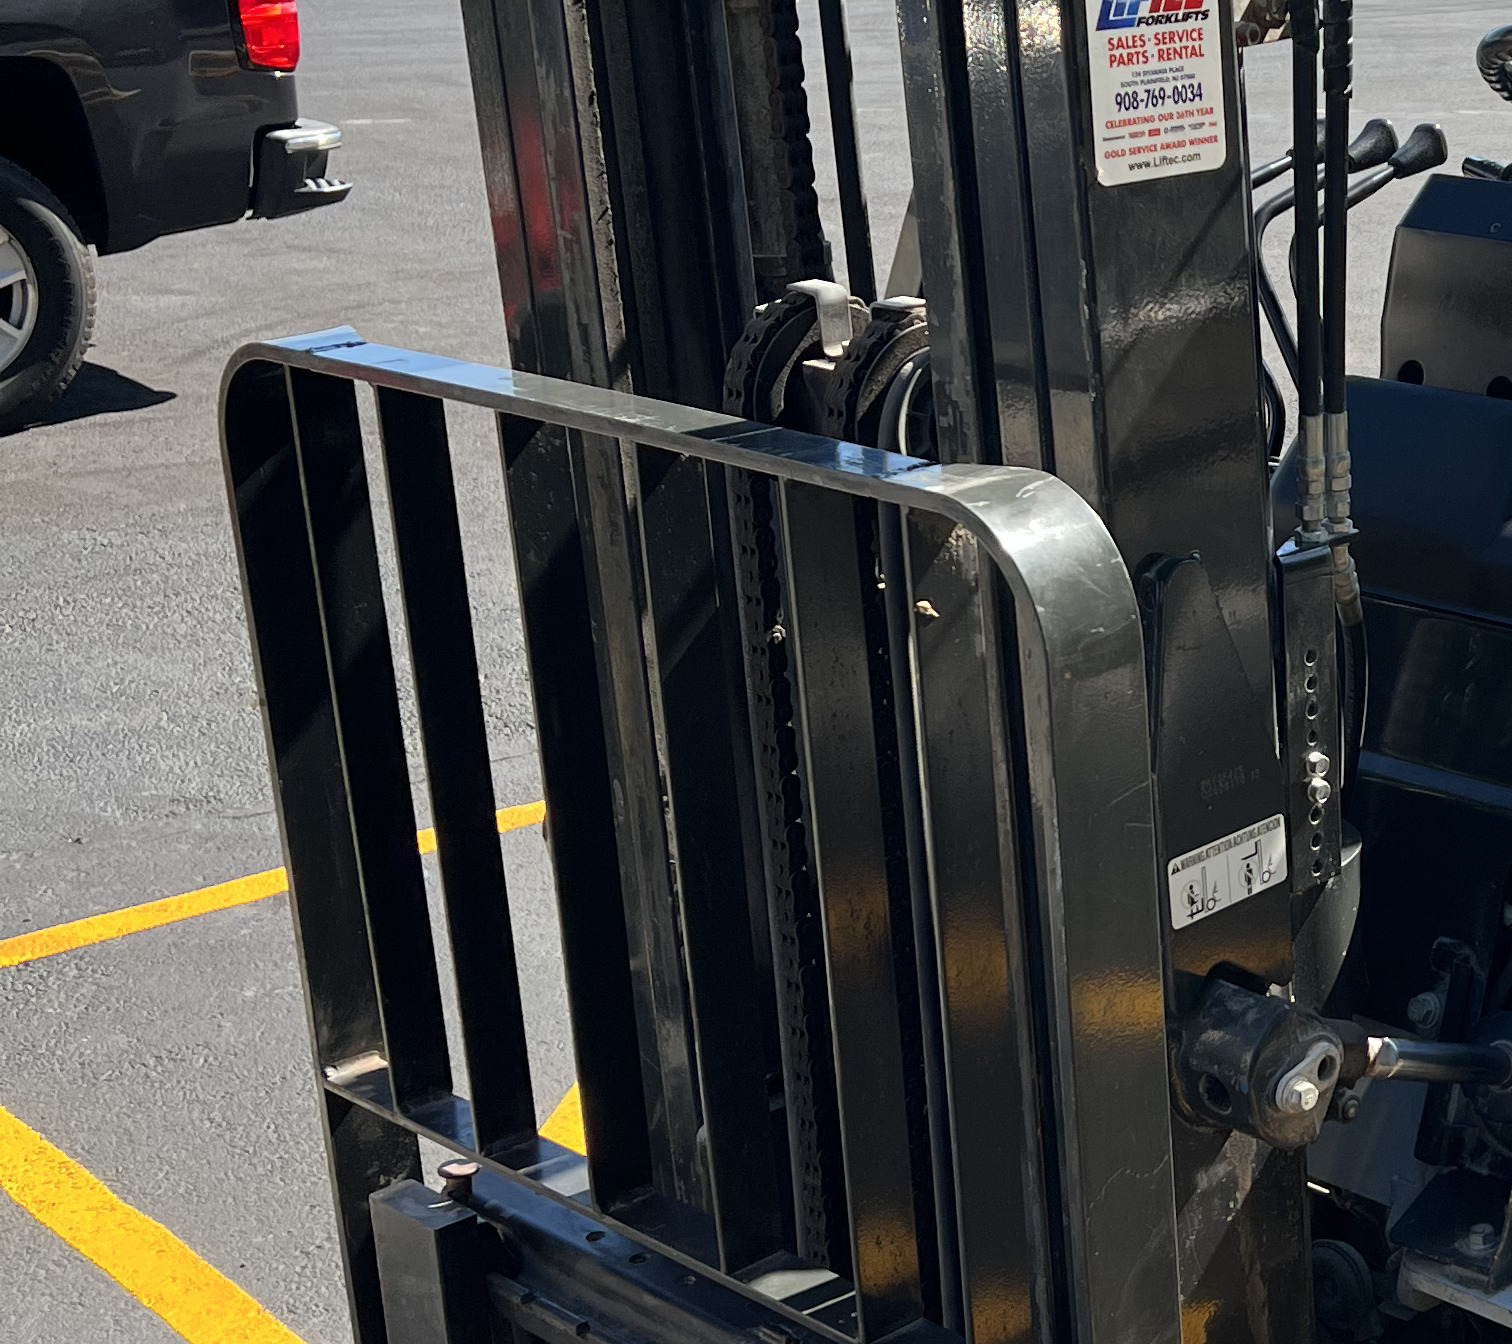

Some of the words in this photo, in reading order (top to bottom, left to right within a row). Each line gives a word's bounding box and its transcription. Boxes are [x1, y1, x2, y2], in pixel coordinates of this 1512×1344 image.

[1137, 9, 1210, 27] FORKLIFTS
[1108, 34, 1146, 51] SALES
[1153, 28, 1204, 46] SERVICE
[1109, 50, 1149, 68] PARTS
[1158, 43, 1204, 62] RENTAL
[1115, 82, 1203, 112] 908-769-0034
[1105, 115, 1155, 130] CELEBRATING
[1158, 112, 1174, 122] OUR
[1196, 107, 1214, 117] YEAR
[1104, 148, 1126, 159] GOLD
[1129, 144, 1158, 156] SERVICE
[1160, 139, 1187, 151] AWARD
[1189, 135, 1218, 146] WINNER
[1128, 153, 1201, 171] www.Liftec.com
